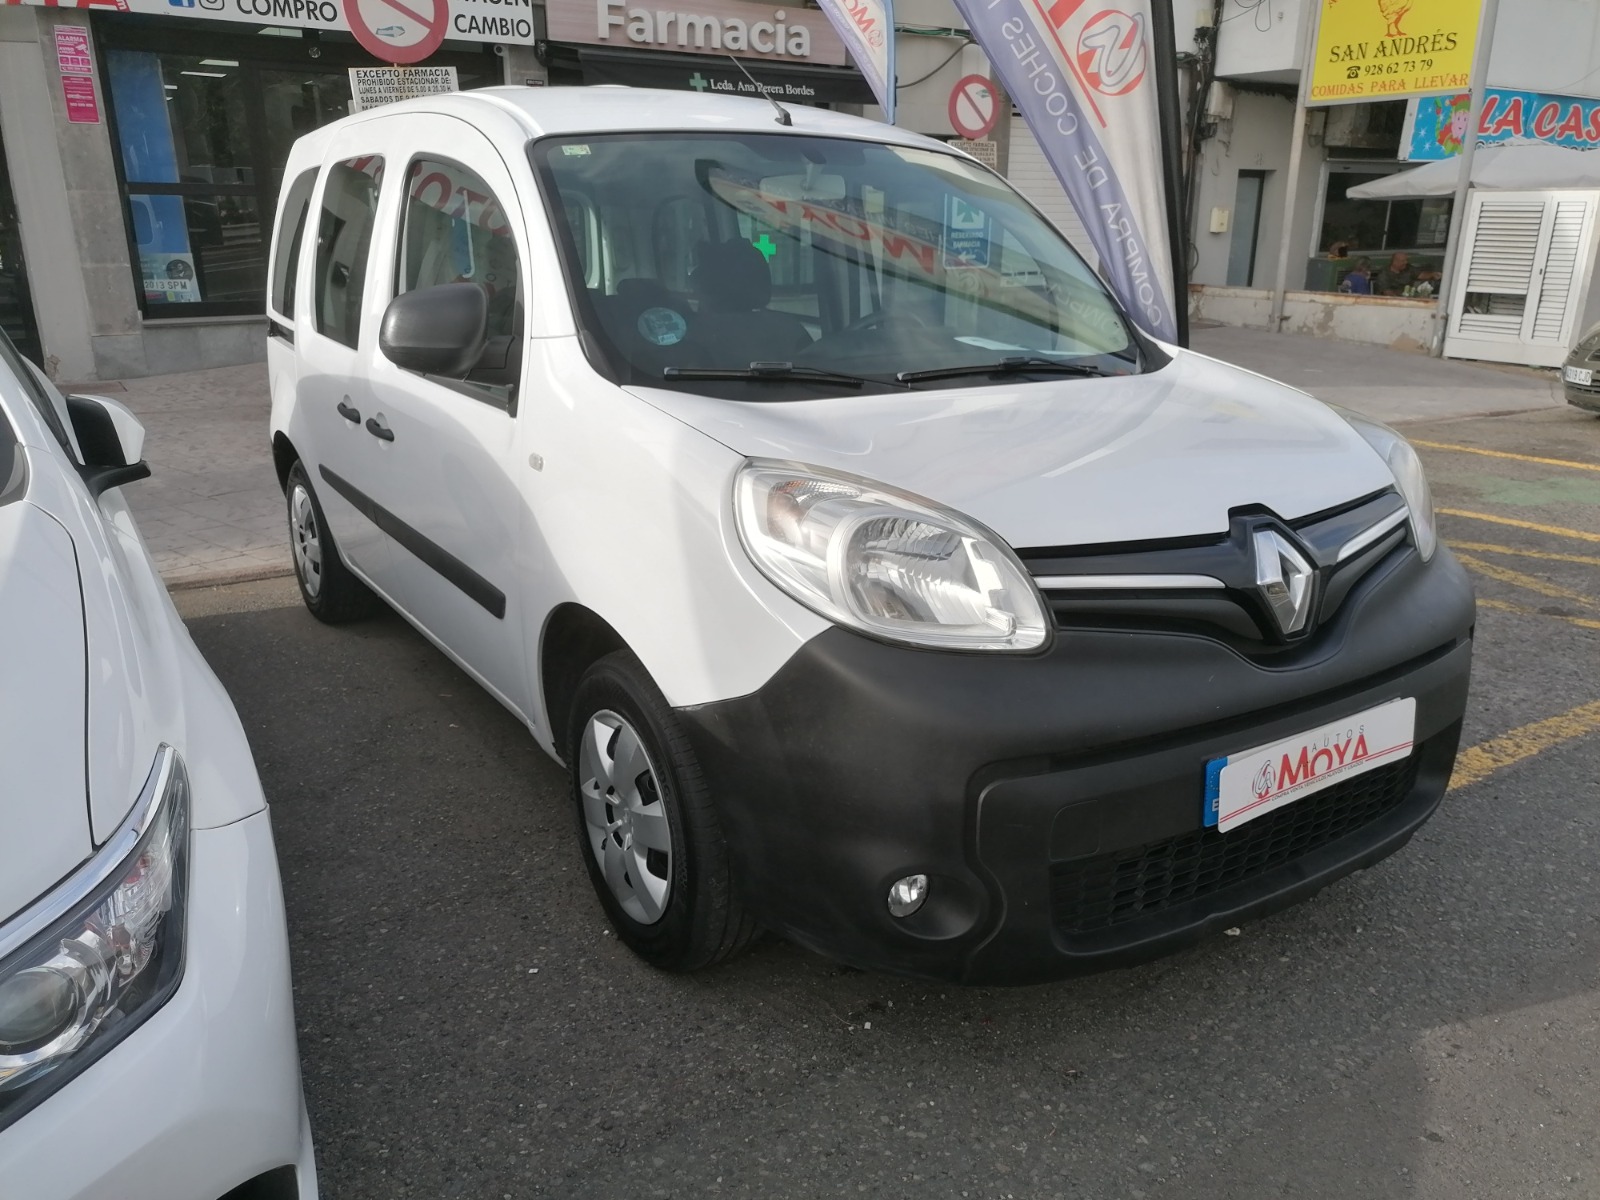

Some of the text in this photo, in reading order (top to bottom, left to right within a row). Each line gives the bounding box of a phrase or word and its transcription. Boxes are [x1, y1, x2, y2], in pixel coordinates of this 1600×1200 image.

[237, 0, 338, 22] COMPRO
[454, 13, 531, 38] CAMBIO
[598, 0, 811, 57] Farmacia
[1329, 29, 1458, 64] SAN ANDRÉS
[356, 68, 450, 79] EXCEPTO FARMACIA
[1364, 59, 1433, 77] 928 62 73 79
[357, 78, 395, 86] PROHIBIDO
[397, 78, 439, 86] ESTACIONAR
[359, 87, 377, 95] LUNES
[383, 86, 407, 94] VIERNES
[710, 79, 735, 91] Lcda.
[737, 81, 755, 92] Ana
[785, 84, 815, 96] Bordes
[1311, 73, 1469, 97] COMIDAS PARA LLEVAR
[1478, 96, 1600, 142] LA CAS
[1312, 725, 1365, 752] AUTOS
[1277, 734, 1369, 791] MOYA
